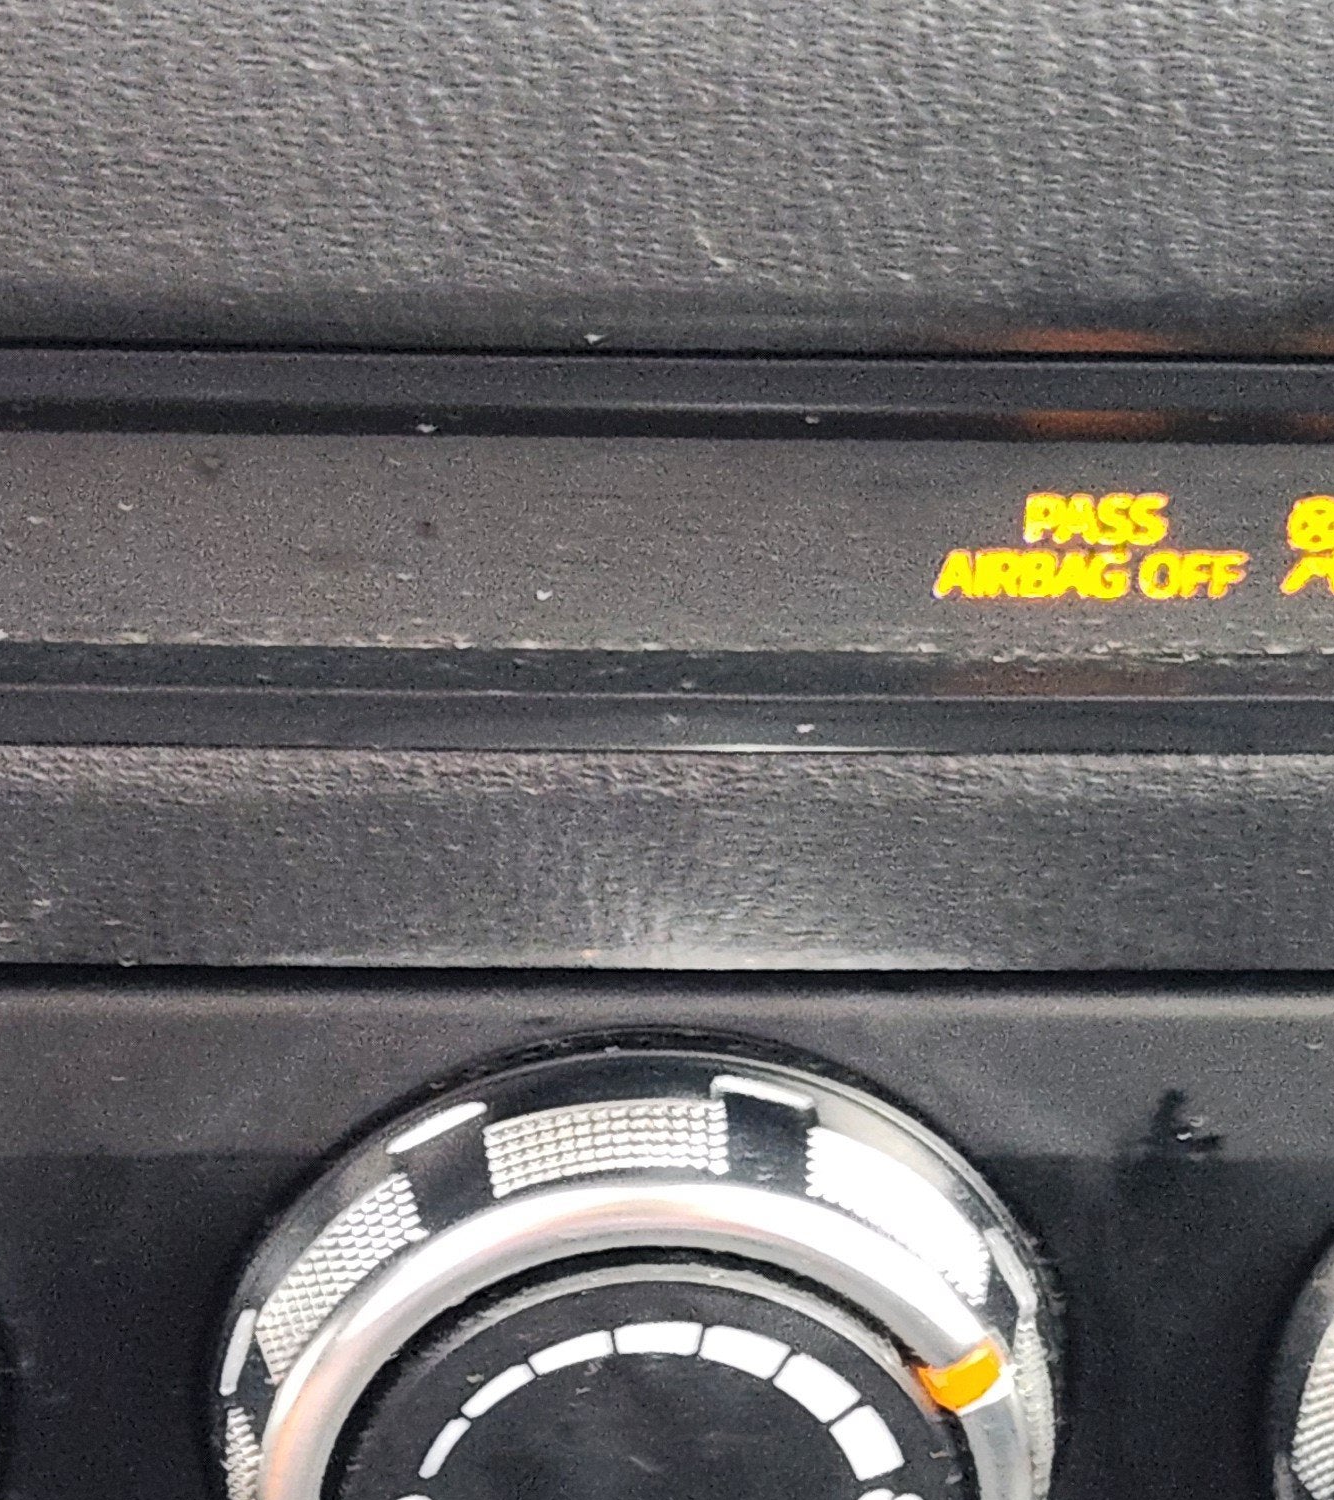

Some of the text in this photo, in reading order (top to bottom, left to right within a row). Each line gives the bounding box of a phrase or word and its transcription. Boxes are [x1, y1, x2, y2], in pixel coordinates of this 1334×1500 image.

[1024, 494, 1167, 545] PASS
[934, 550, 1249, 599] AIRBAG OFF
